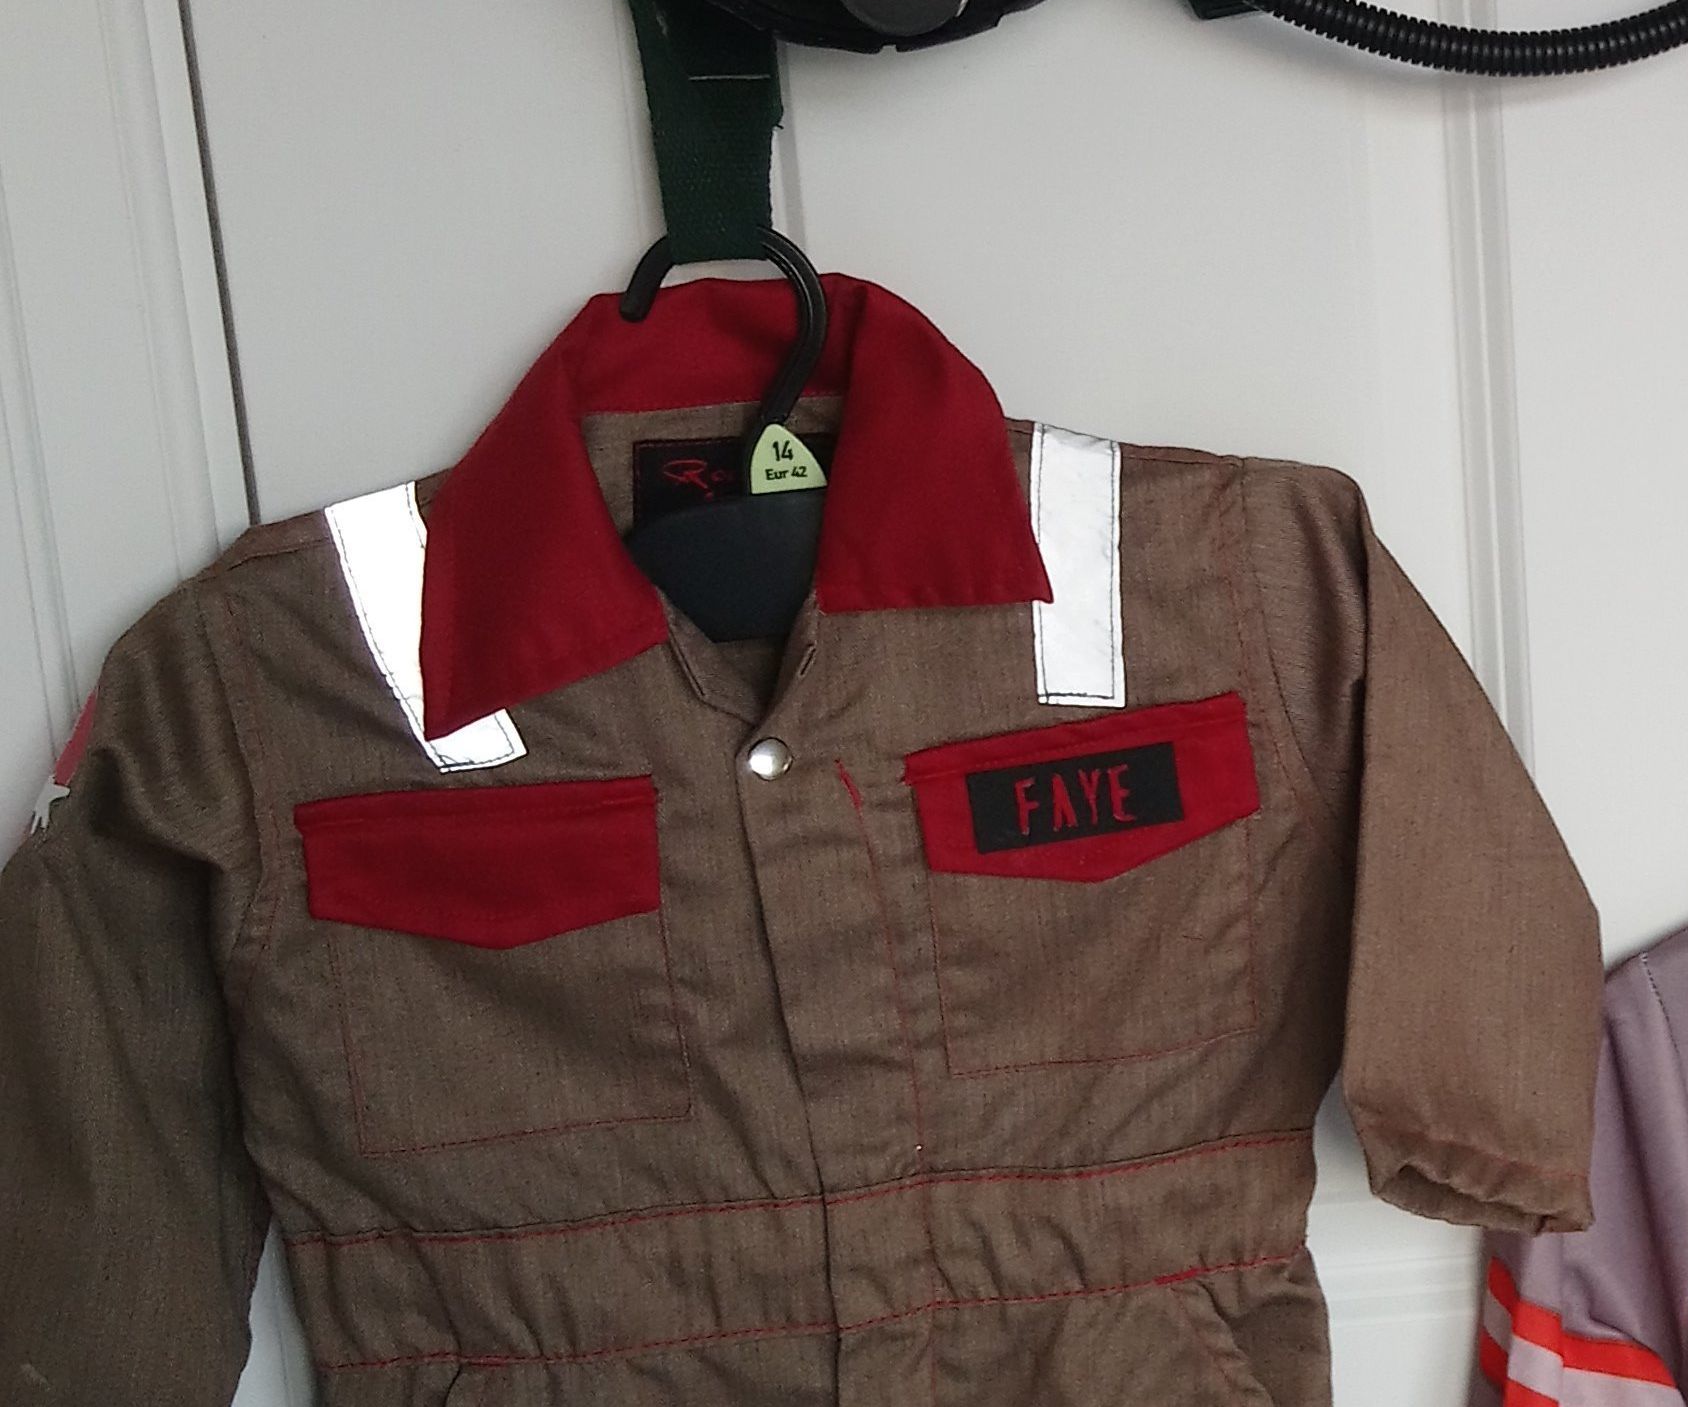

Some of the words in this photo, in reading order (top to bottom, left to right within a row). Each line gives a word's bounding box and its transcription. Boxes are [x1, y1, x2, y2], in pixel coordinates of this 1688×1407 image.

[772, 440, 794, 462] 14
[765, 468, 788, 481] Eur
[790, 465, 808, 478] 42
[1013, 763, 1138, 836] FAYE
